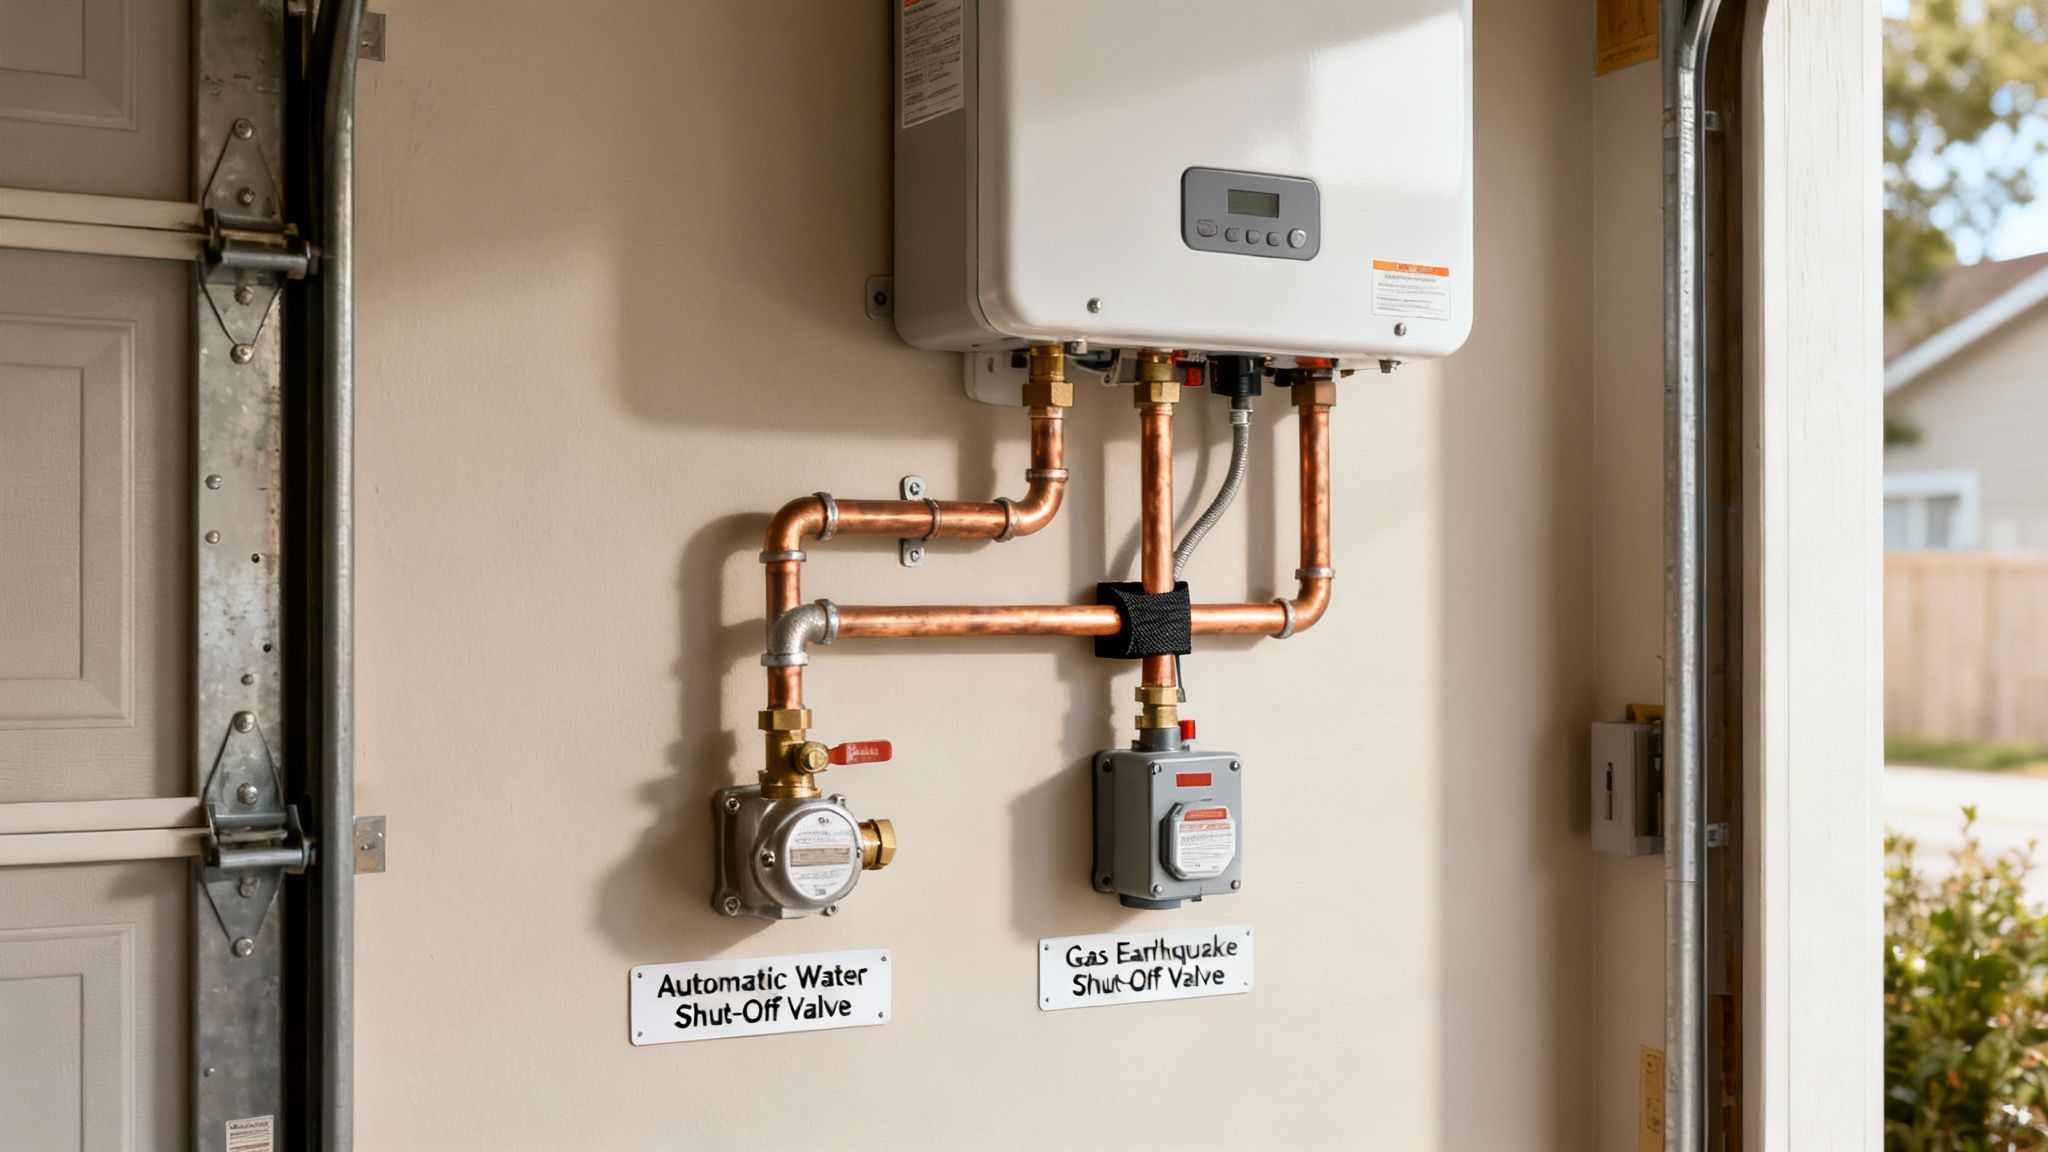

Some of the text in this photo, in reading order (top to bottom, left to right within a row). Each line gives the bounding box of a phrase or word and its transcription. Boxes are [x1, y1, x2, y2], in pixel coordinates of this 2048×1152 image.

[1066, 934, 1238, 967] Gas Earthquake
[657, 965, 868, 998] Automatic Water
[1168, 965, 1225, 988] Valve
[674, 996, 852, 1029] Shut-Off Valve
